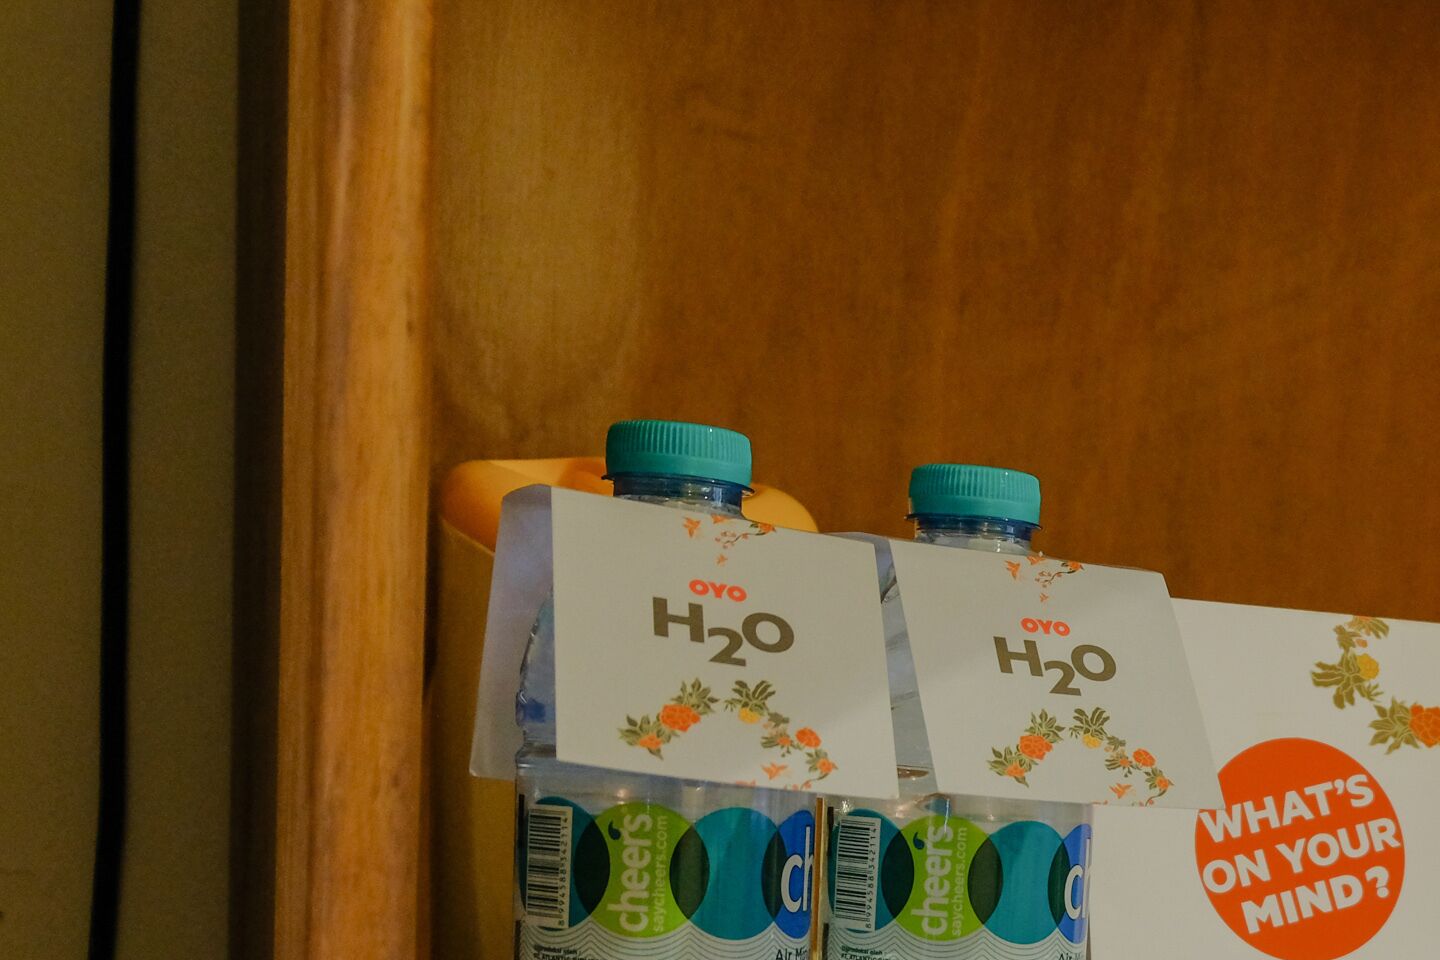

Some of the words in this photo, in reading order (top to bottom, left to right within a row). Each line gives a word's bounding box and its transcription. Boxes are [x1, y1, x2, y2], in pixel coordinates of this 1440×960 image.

[688, 579, 748, 603] OYO
[652, 596, 795, 668] H2O
[1020, 617, 1071, 637] OYO
[993, 635, 1117, 697] H2O
[1199, 773, 1375, 844] WHAT'S
[652, 814, 669, 933] saycheers.com
[951, 826, 968, 937] saycheers.com
[1201, 853, 1272, 894] ON
[1276, 817, 1401, 875] YOUR
[1240, 865, 1392, 935] MIND?
